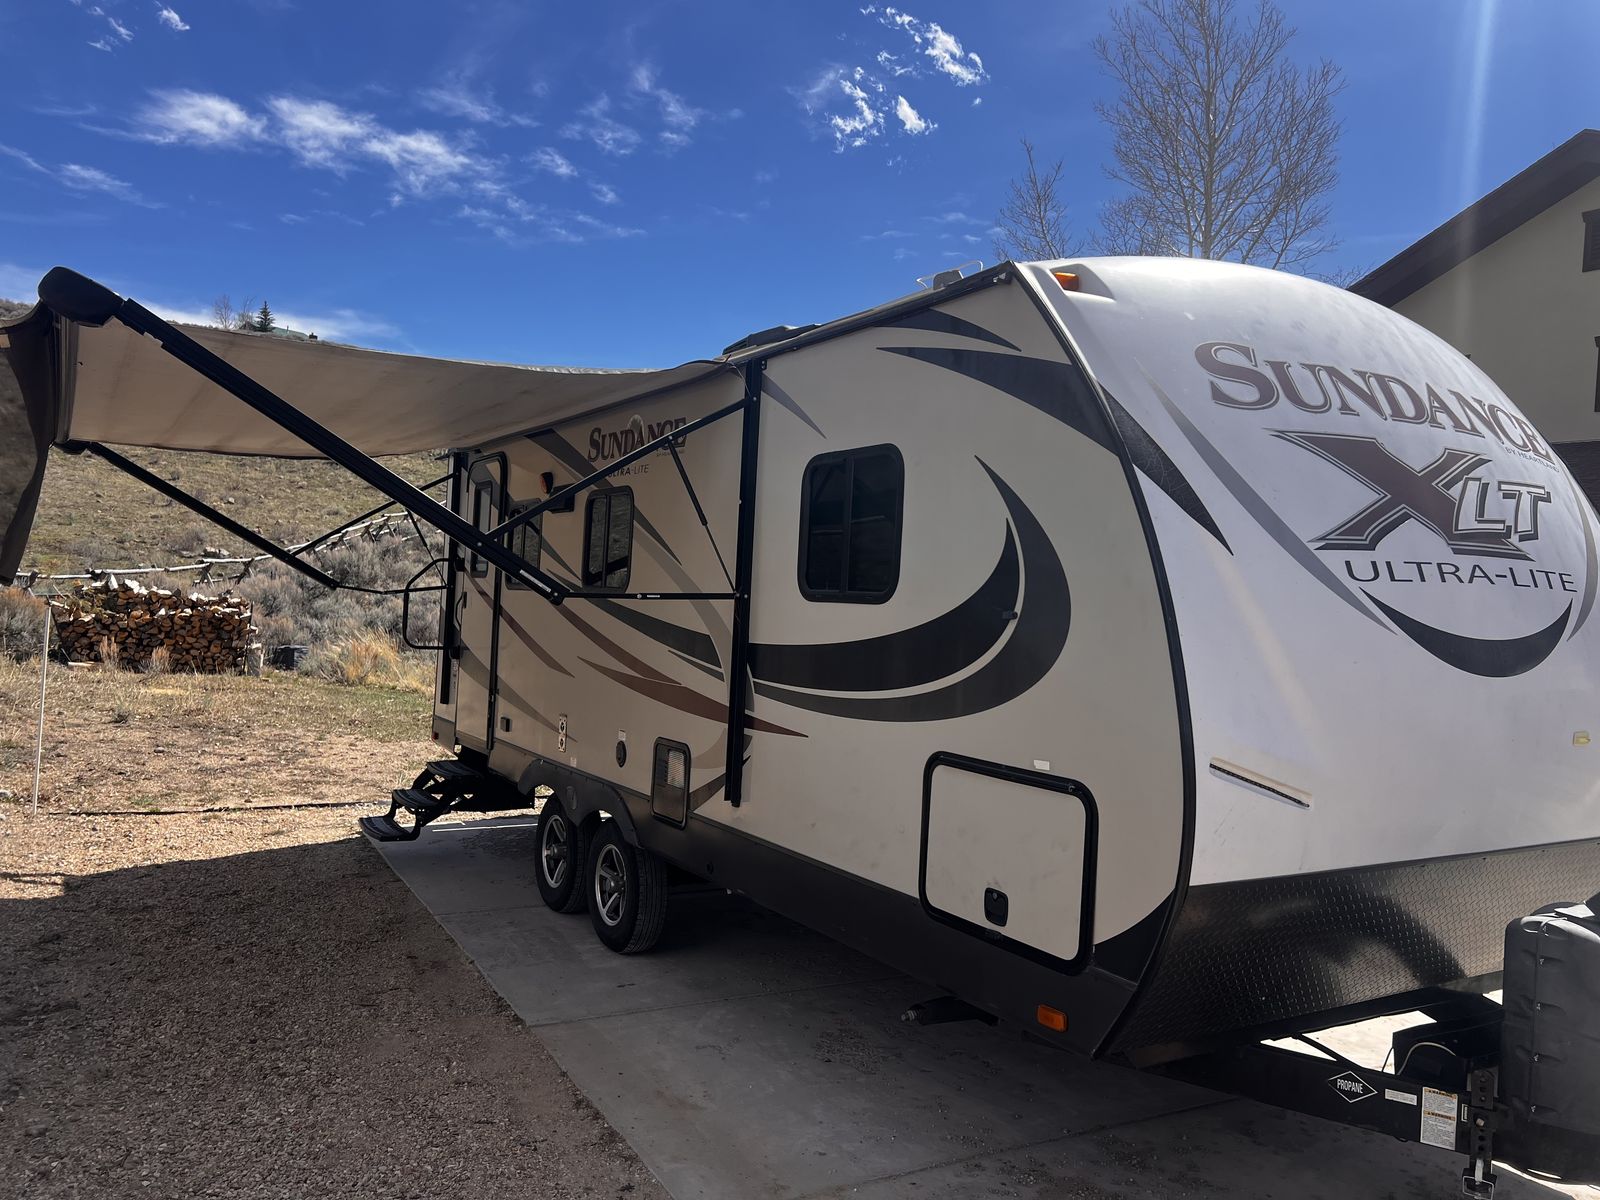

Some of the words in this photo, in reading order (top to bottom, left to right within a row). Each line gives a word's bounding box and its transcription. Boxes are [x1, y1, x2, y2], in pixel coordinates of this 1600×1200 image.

[1195, 341, 1556, 465] SUNDANCE
[588, 416, 687, 462] SUNDANCE
[1262, 427, 1551, 562] XLT
[1344, 559, 1578, 593] ULTRA-LITE
[1336, 1078, 1363, 1094] PROPANE
